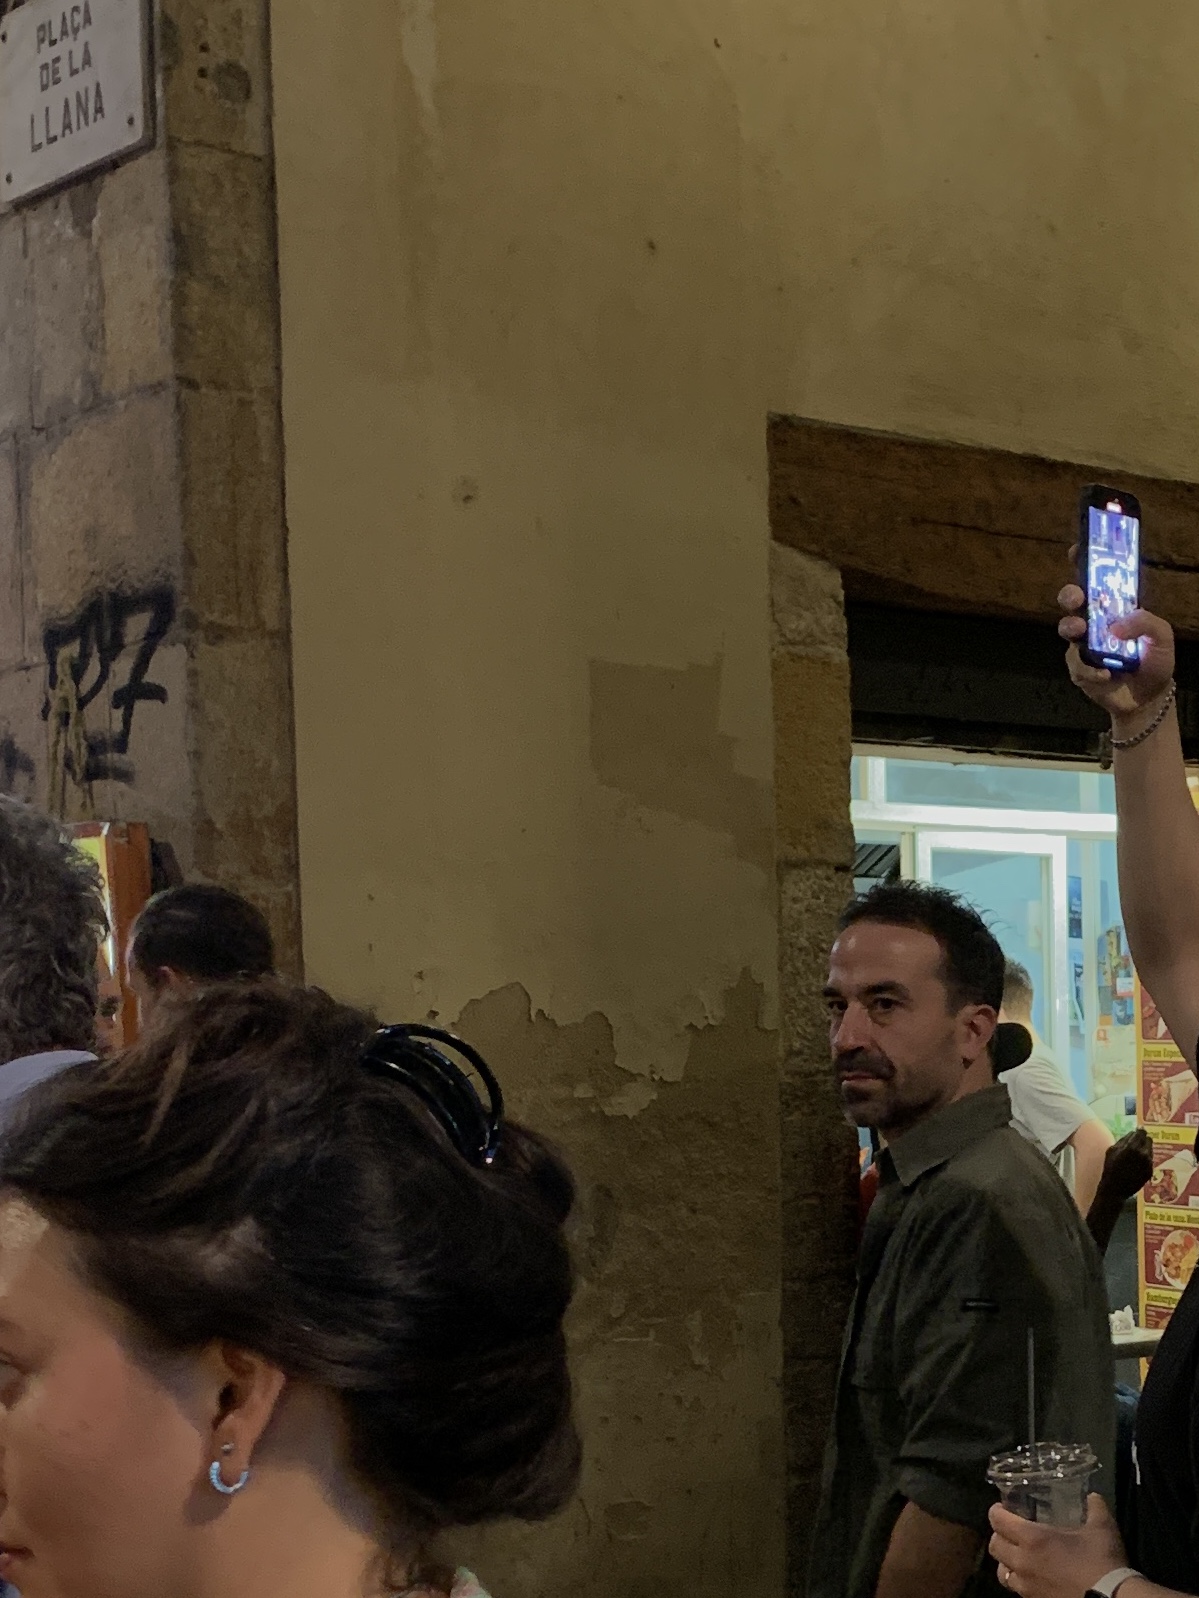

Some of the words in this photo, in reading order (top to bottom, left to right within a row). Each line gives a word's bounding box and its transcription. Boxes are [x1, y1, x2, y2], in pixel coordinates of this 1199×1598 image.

[36, 0, 92, 54] PLAÇA
[40, 55, 62, 92] DE
[68, 41, 92, 78] LA
[31, 82, 105, 153] LLANA
